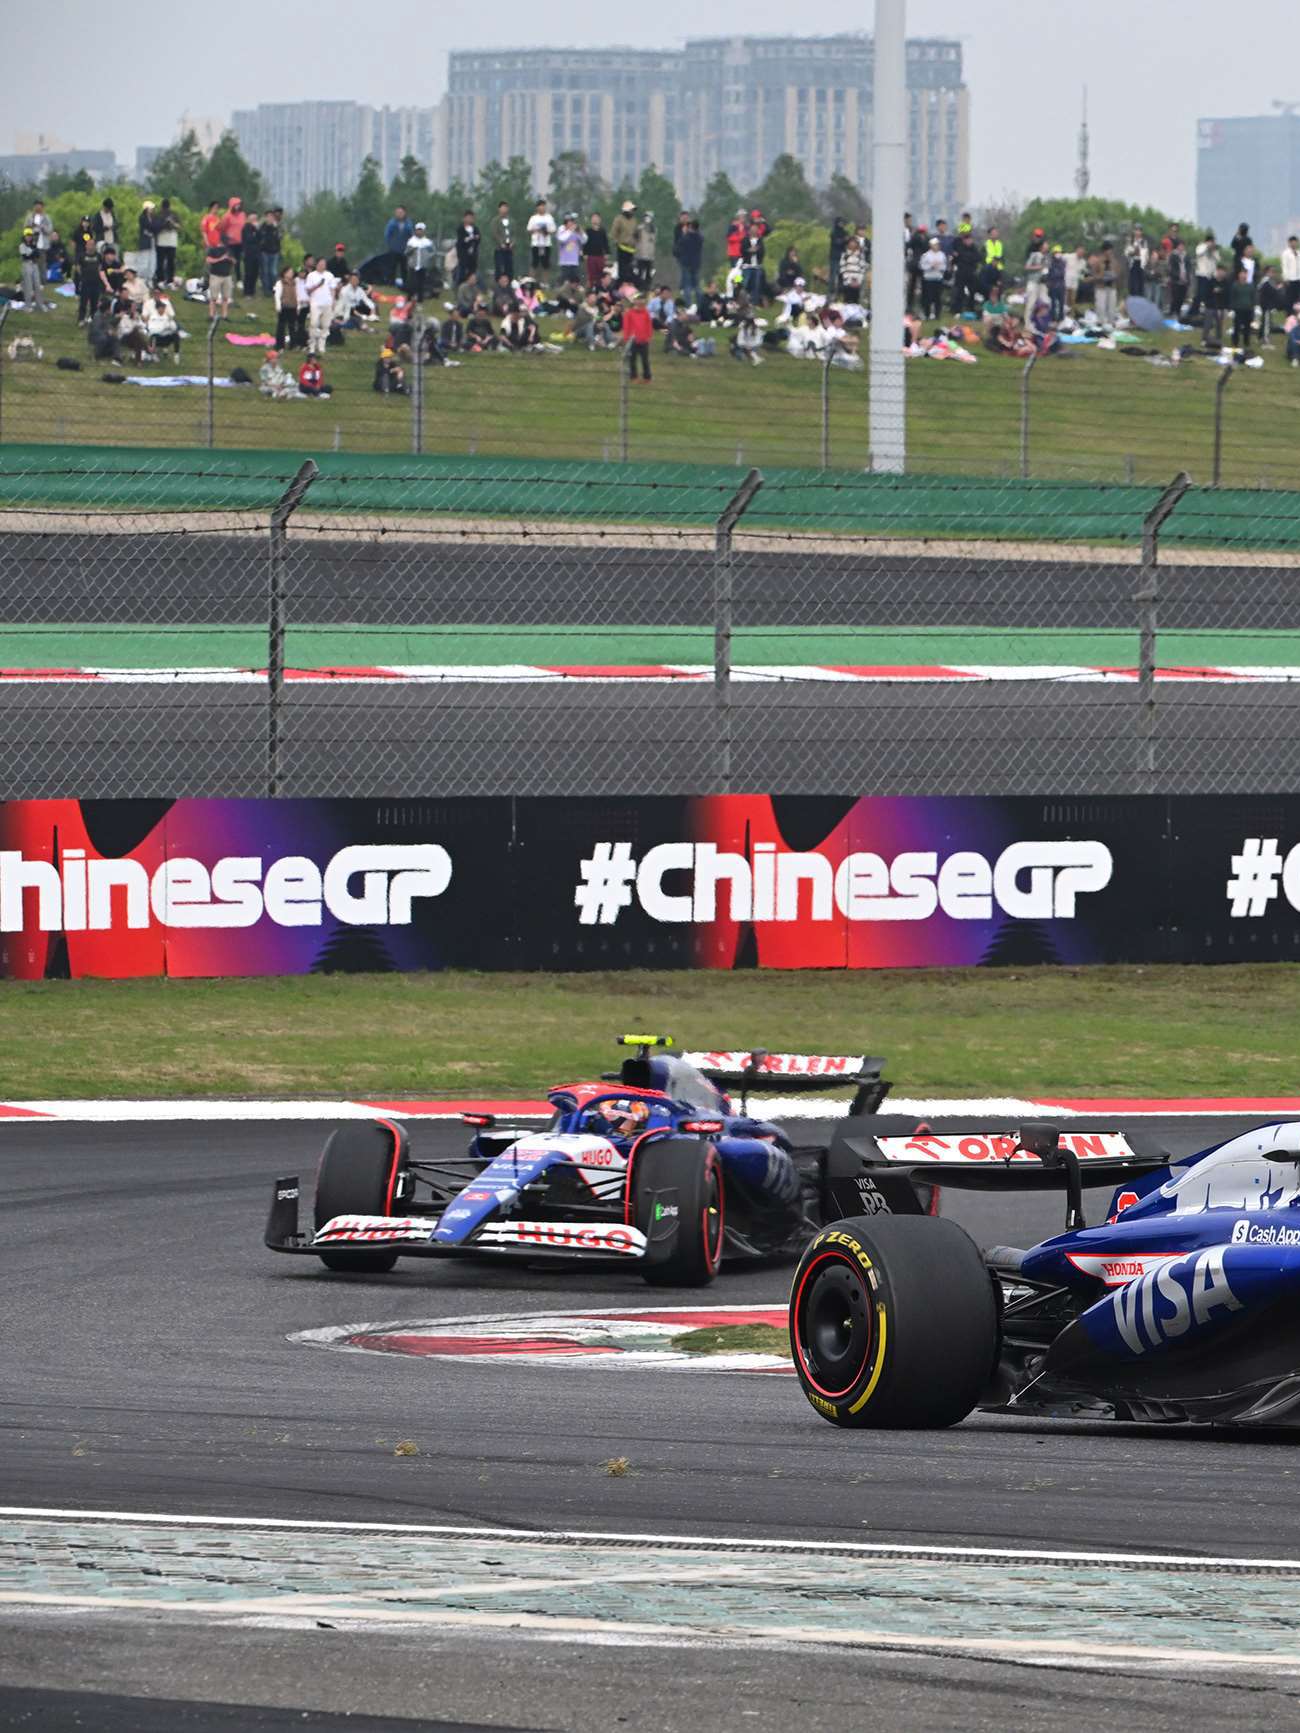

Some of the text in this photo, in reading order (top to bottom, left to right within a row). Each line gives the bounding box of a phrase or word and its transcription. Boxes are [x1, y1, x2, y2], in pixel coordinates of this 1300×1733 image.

[575, 840, 1113, 924] #ChineseGP
[581, 1149, 613, 1165] HUGO
[854, 1178, 877, 1190] VISA
[517, 1223, 633, 1250] HUGO
[1249, 1225, 1276, 1243] Cash
[1276, 1225, 1300, 1245] App
[825, 1231, 873, 1270] ZERO
[1101, 1261, 1145, 1277] HONDA
[1113, 1243, 1245, 1355] VISA
